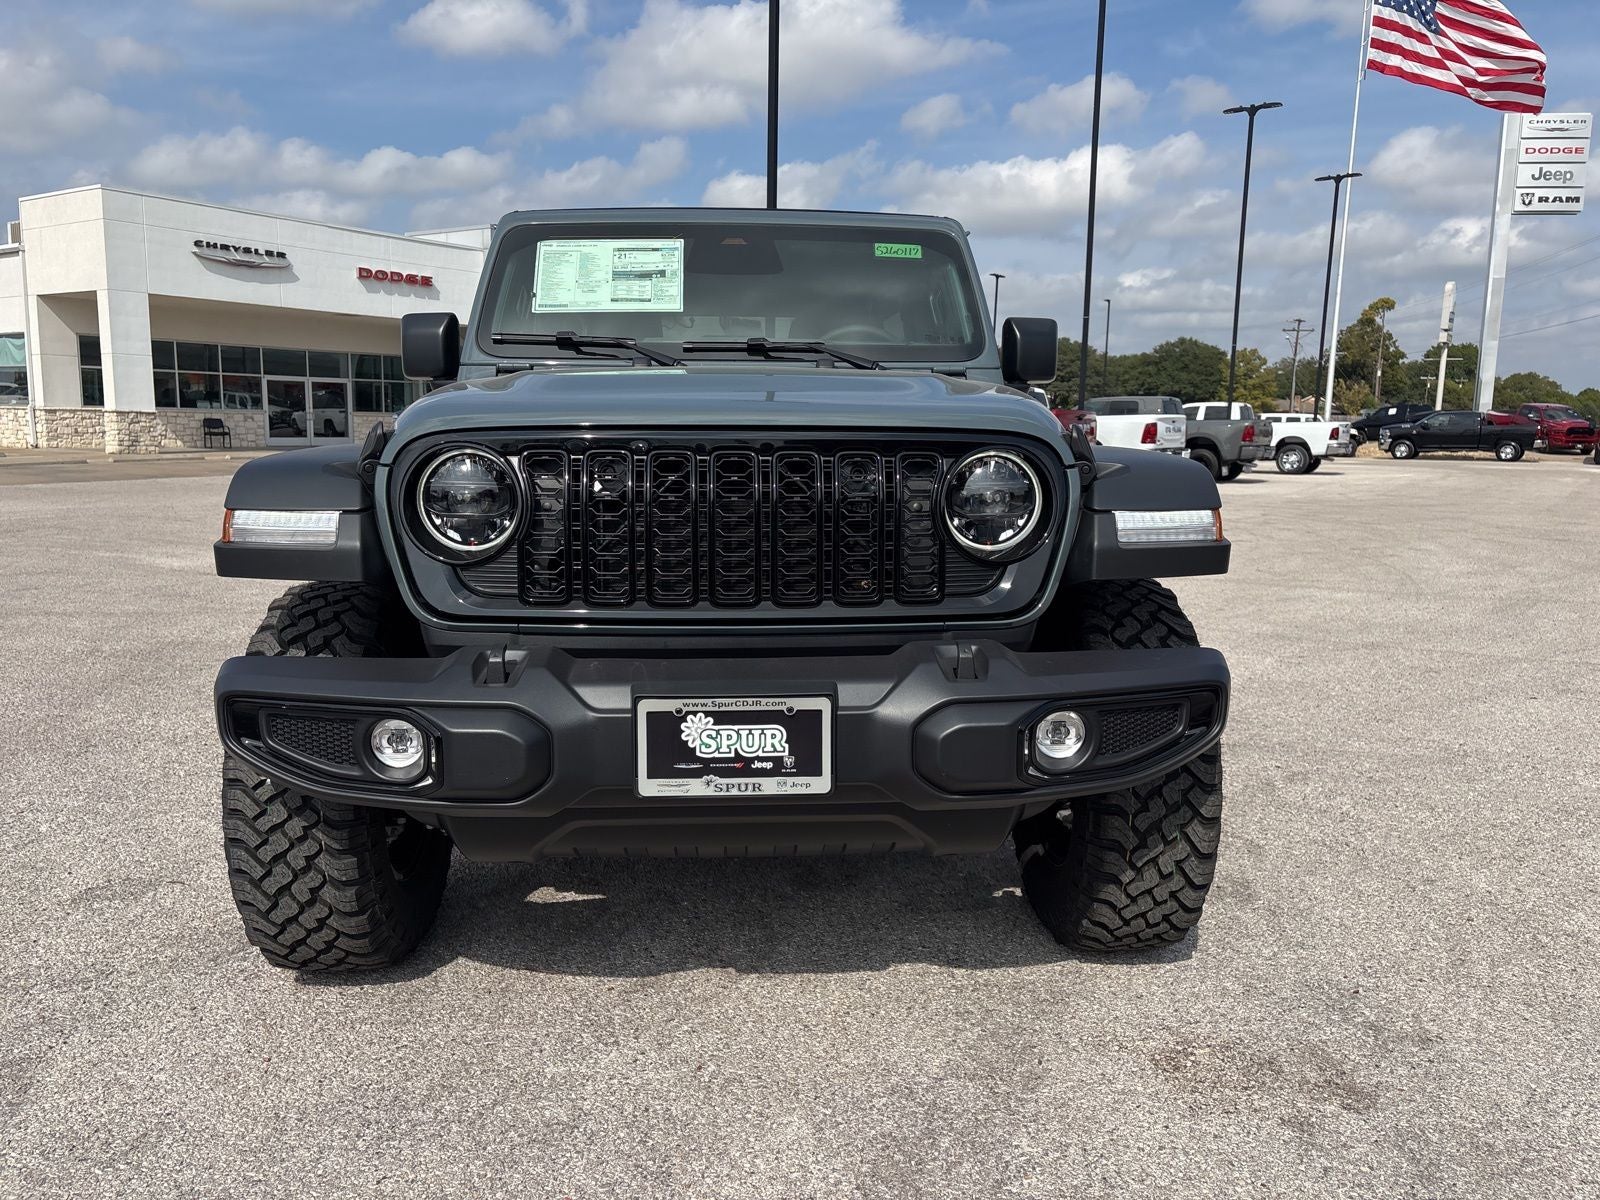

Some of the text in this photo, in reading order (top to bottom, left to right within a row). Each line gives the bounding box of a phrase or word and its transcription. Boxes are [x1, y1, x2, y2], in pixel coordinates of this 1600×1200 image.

[1531, 167, 1574, 184] Jeep
[193, 239, 287, 259] CHRYSLER
[357, 267, 433, 287] DODGE
[682, 700, 787, 709] www.SpurCDJR.com
[699, 727, 787, 755] SPUR
[751, 760, 774, 769] Jeep
[714, 782, 763, 793] SPUR
[790, 781, 811, 789] Jeep
